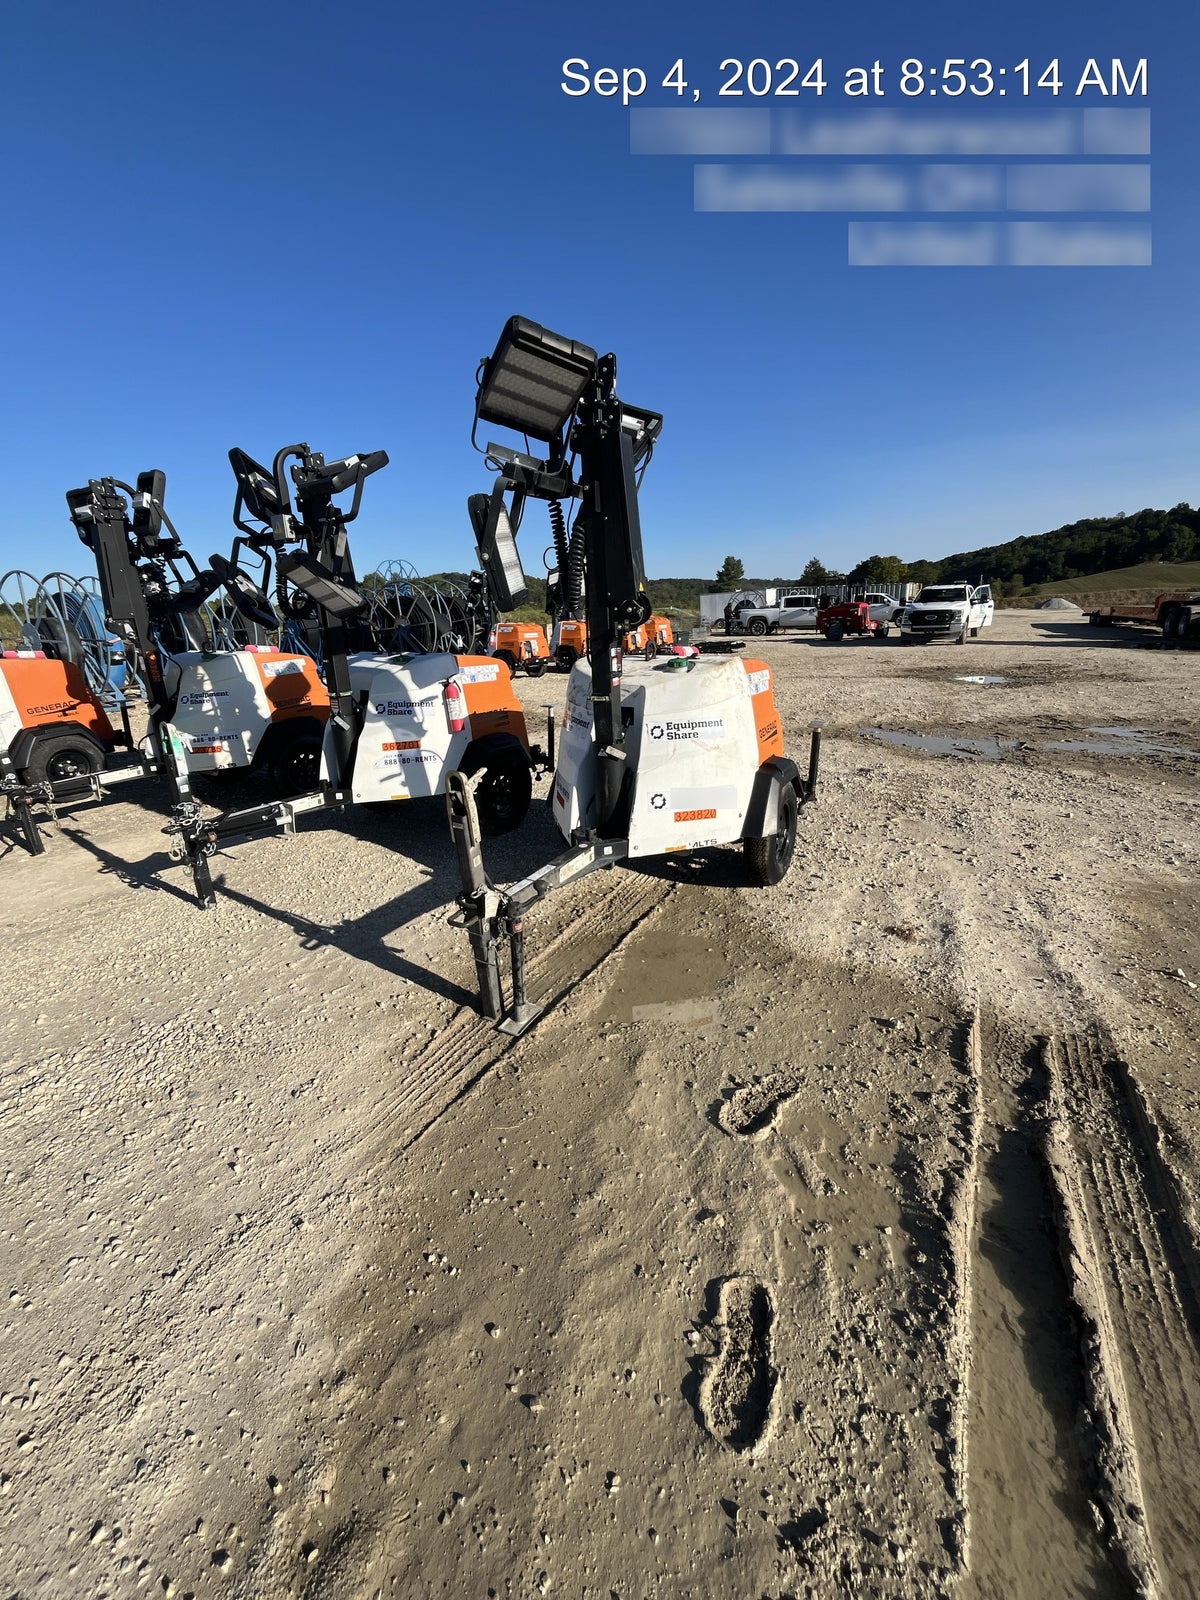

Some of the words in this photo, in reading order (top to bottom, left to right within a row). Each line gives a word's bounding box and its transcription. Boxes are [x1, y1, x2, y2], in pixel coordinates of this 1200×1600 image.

[26, 700, 75, 715] GENERAC
[387, 700, 434, 710] Equipment
[387, 708, 412, 716] Share
[666, 719, 724, 732] Equipment
[666, 731, 699, 741] Share
[675, 809, 717, 822] 323820
